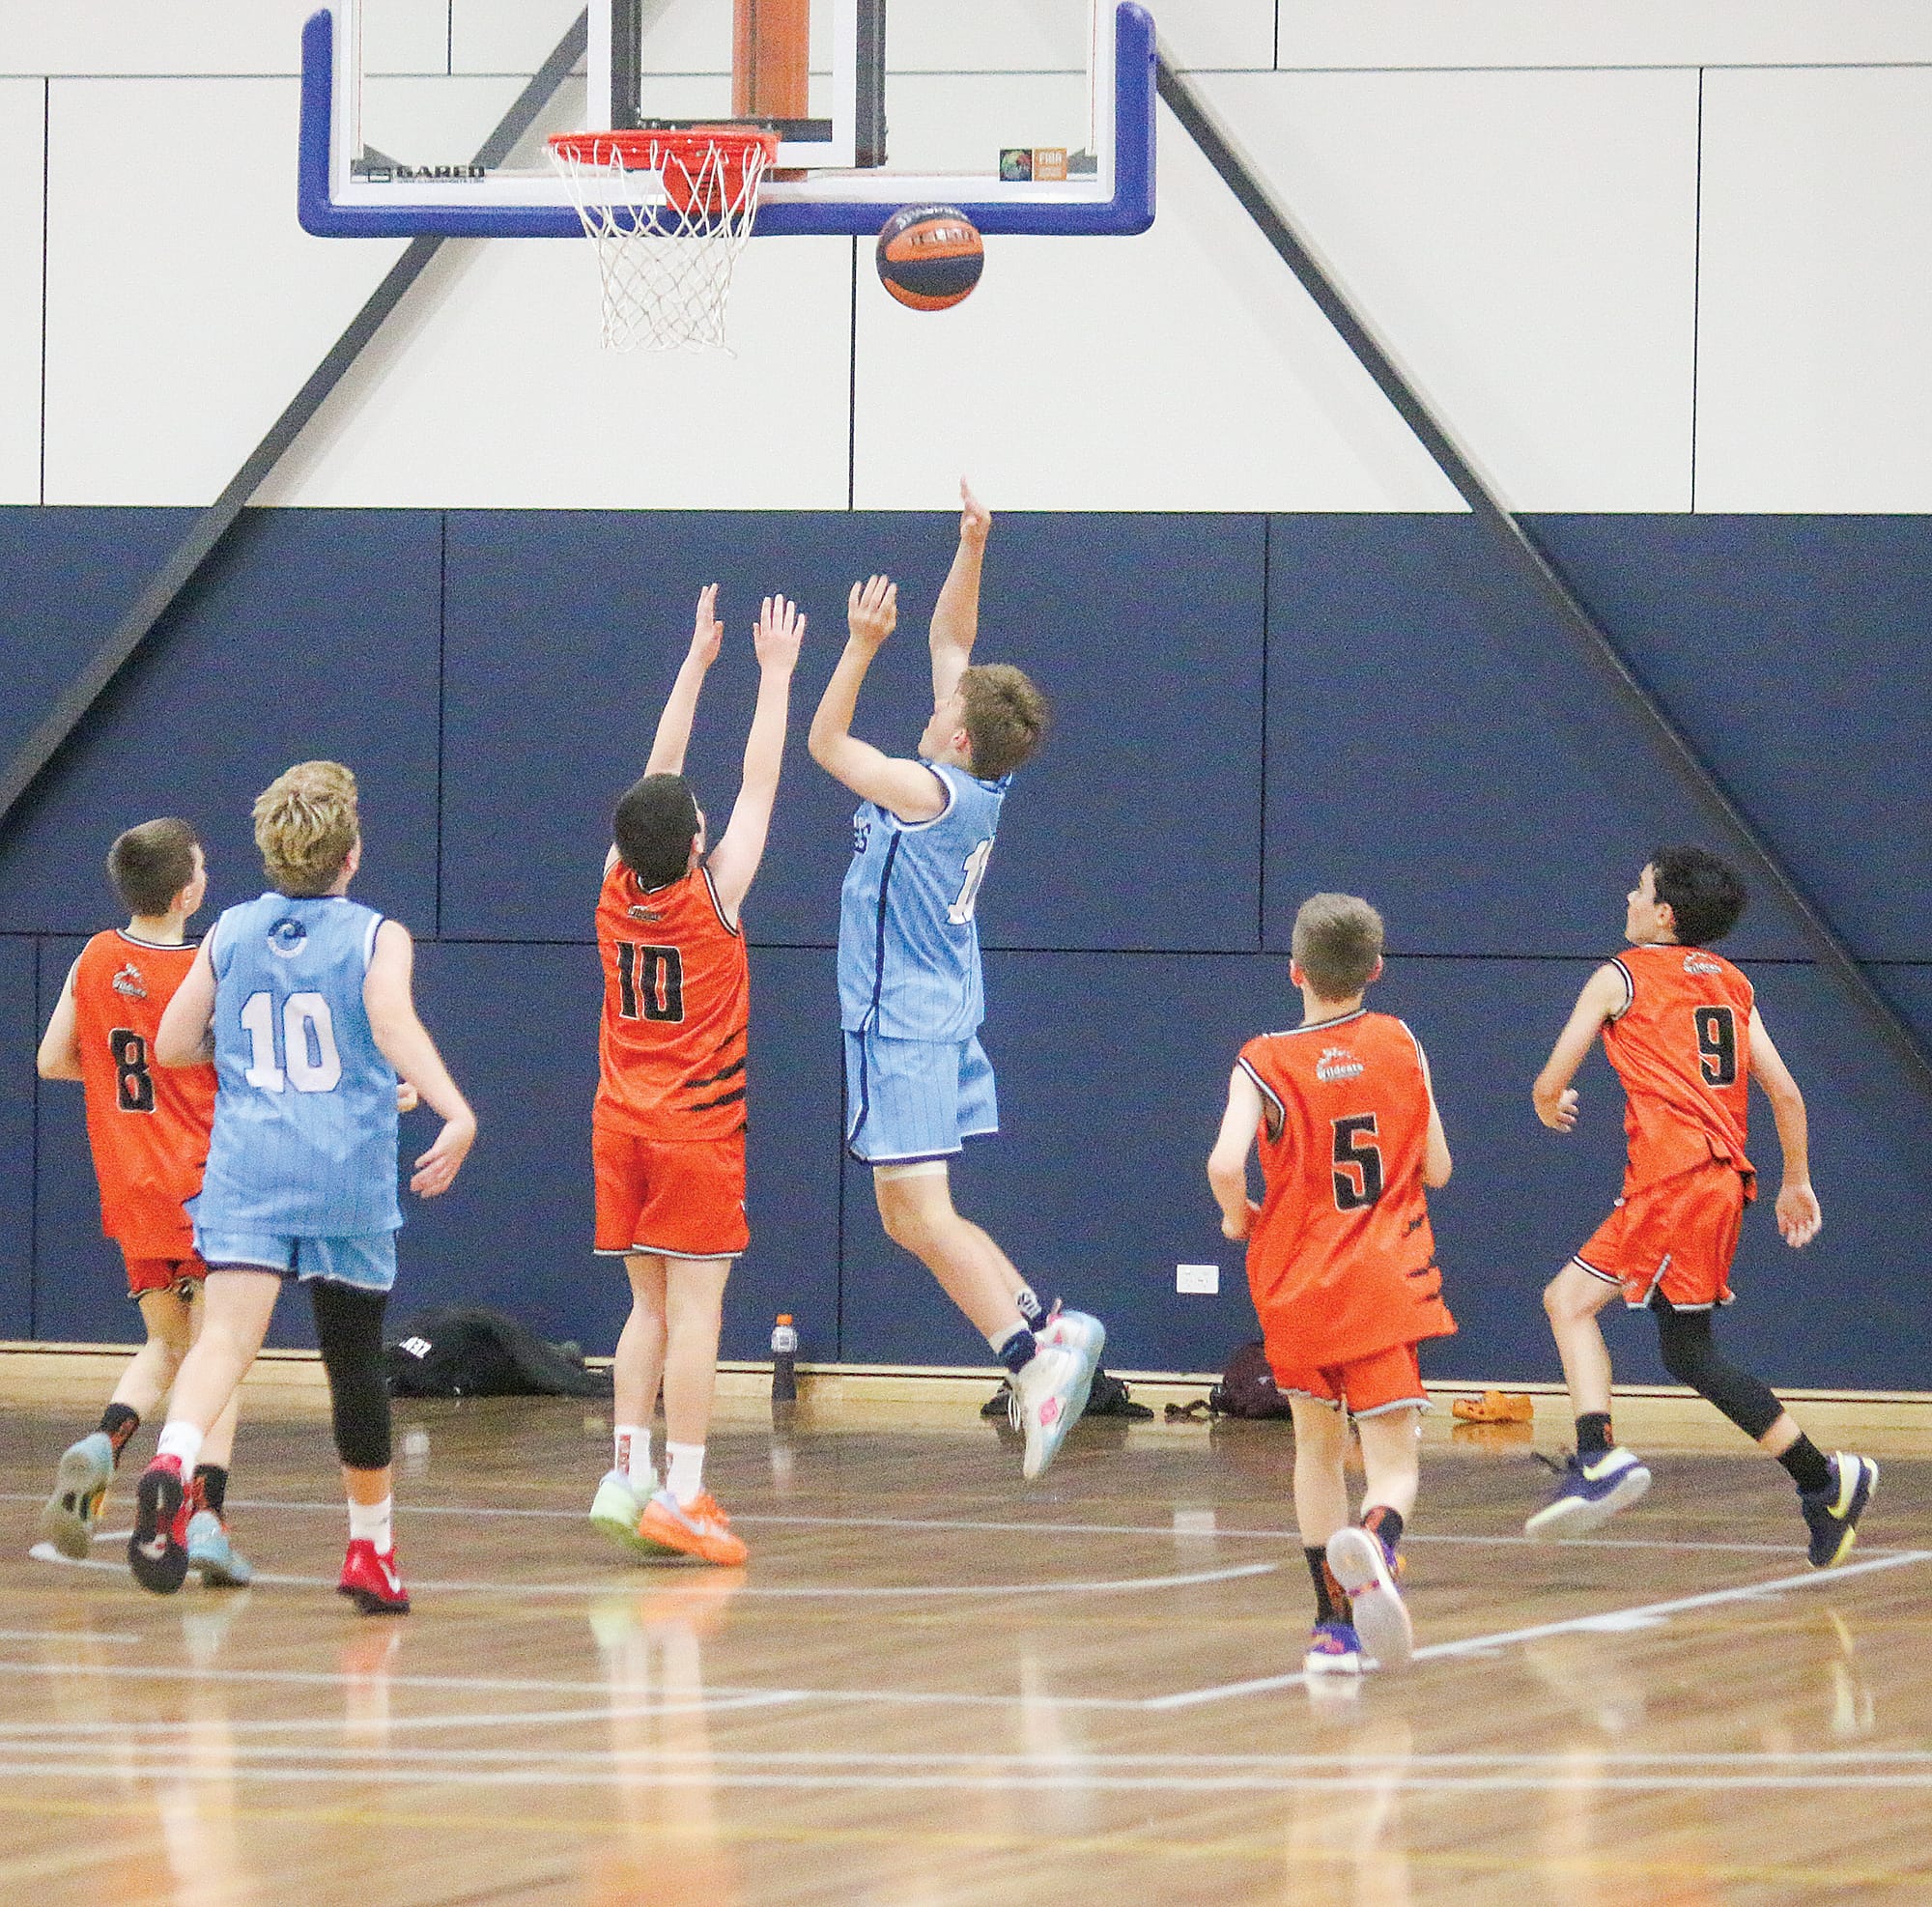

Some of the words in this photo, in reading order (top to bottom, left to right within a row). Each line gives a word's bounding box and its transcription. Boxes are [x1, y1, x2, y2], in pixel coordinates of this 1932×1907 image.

[395, 165, 485, 178] GARED
[614, 940, 684, 1024] 10
[108, 1028, 156, 1114] 8
[240, 991, 342, 1094] 10
[1693, 1005, 1738, 1088] 9
[1331, 1113, 1383, 1211] 5
